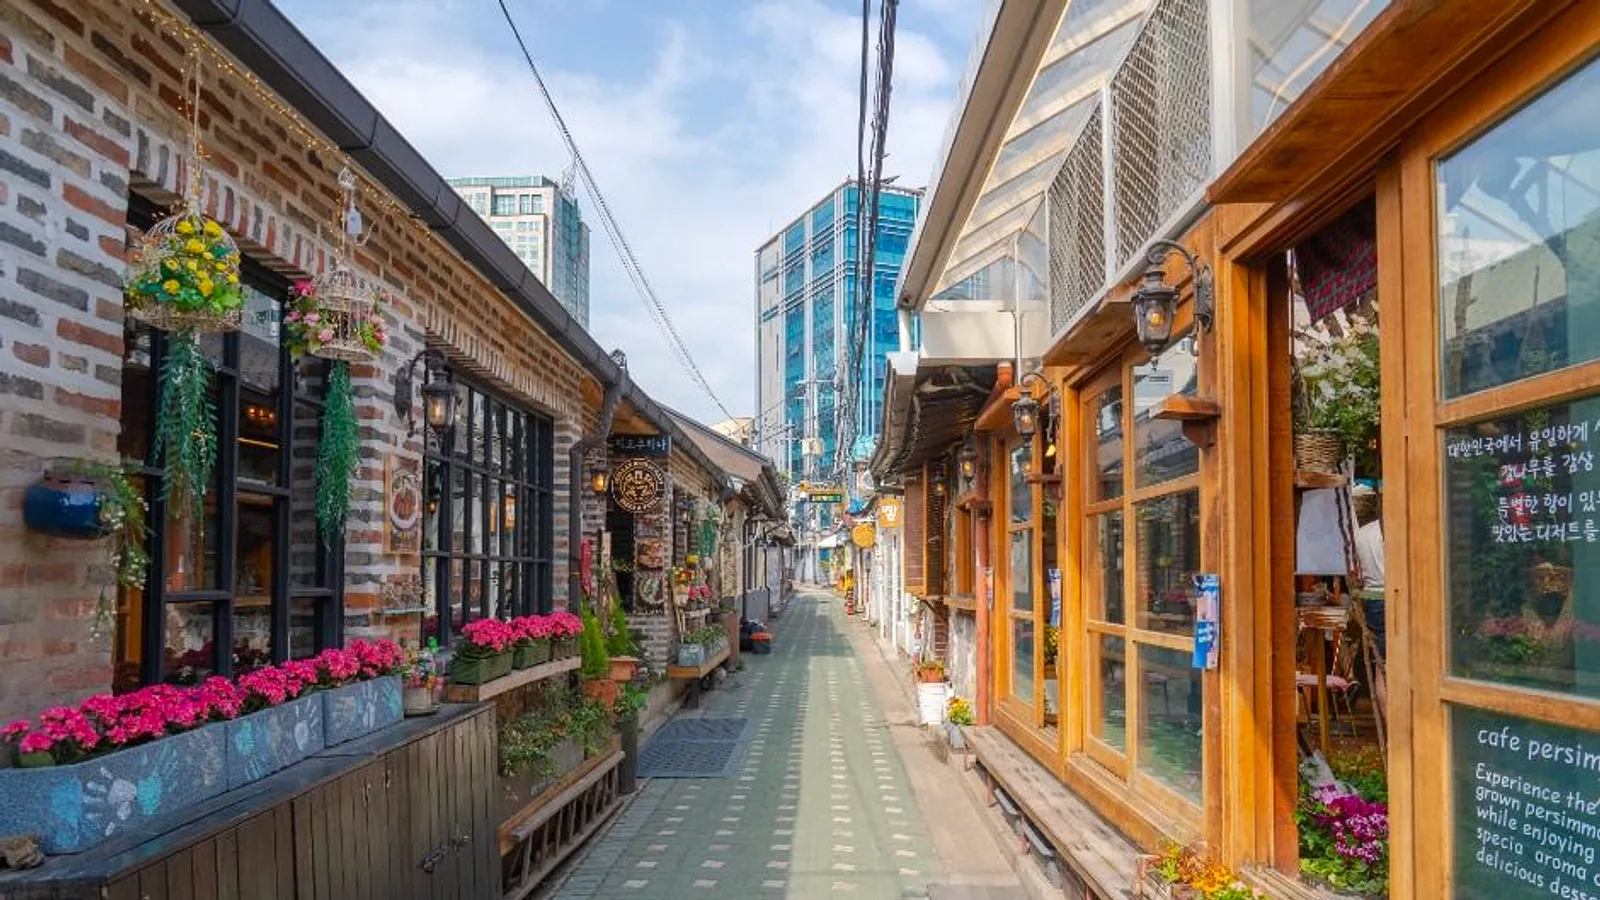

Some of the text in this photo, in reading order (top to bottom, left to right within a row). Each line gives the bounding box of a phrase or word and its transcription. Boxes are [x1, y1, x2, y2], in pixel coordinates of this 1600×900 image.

[1529, 421, 1589, 451] 유일하게
[1579, 490, 1600, 511] 있
[1492, 518, 1599, 543] 맛있는 디저트를
[1477, 726, 1521, 751] cafe
[1475, 762, 1561, 804] Experience
[1475, 786, 1521, 811] grown
[1476, 805, 1596, 865] while enjoying
[1476, 847, 1545, 889] delicious
[1535, 849, 1587, 881] aroma
